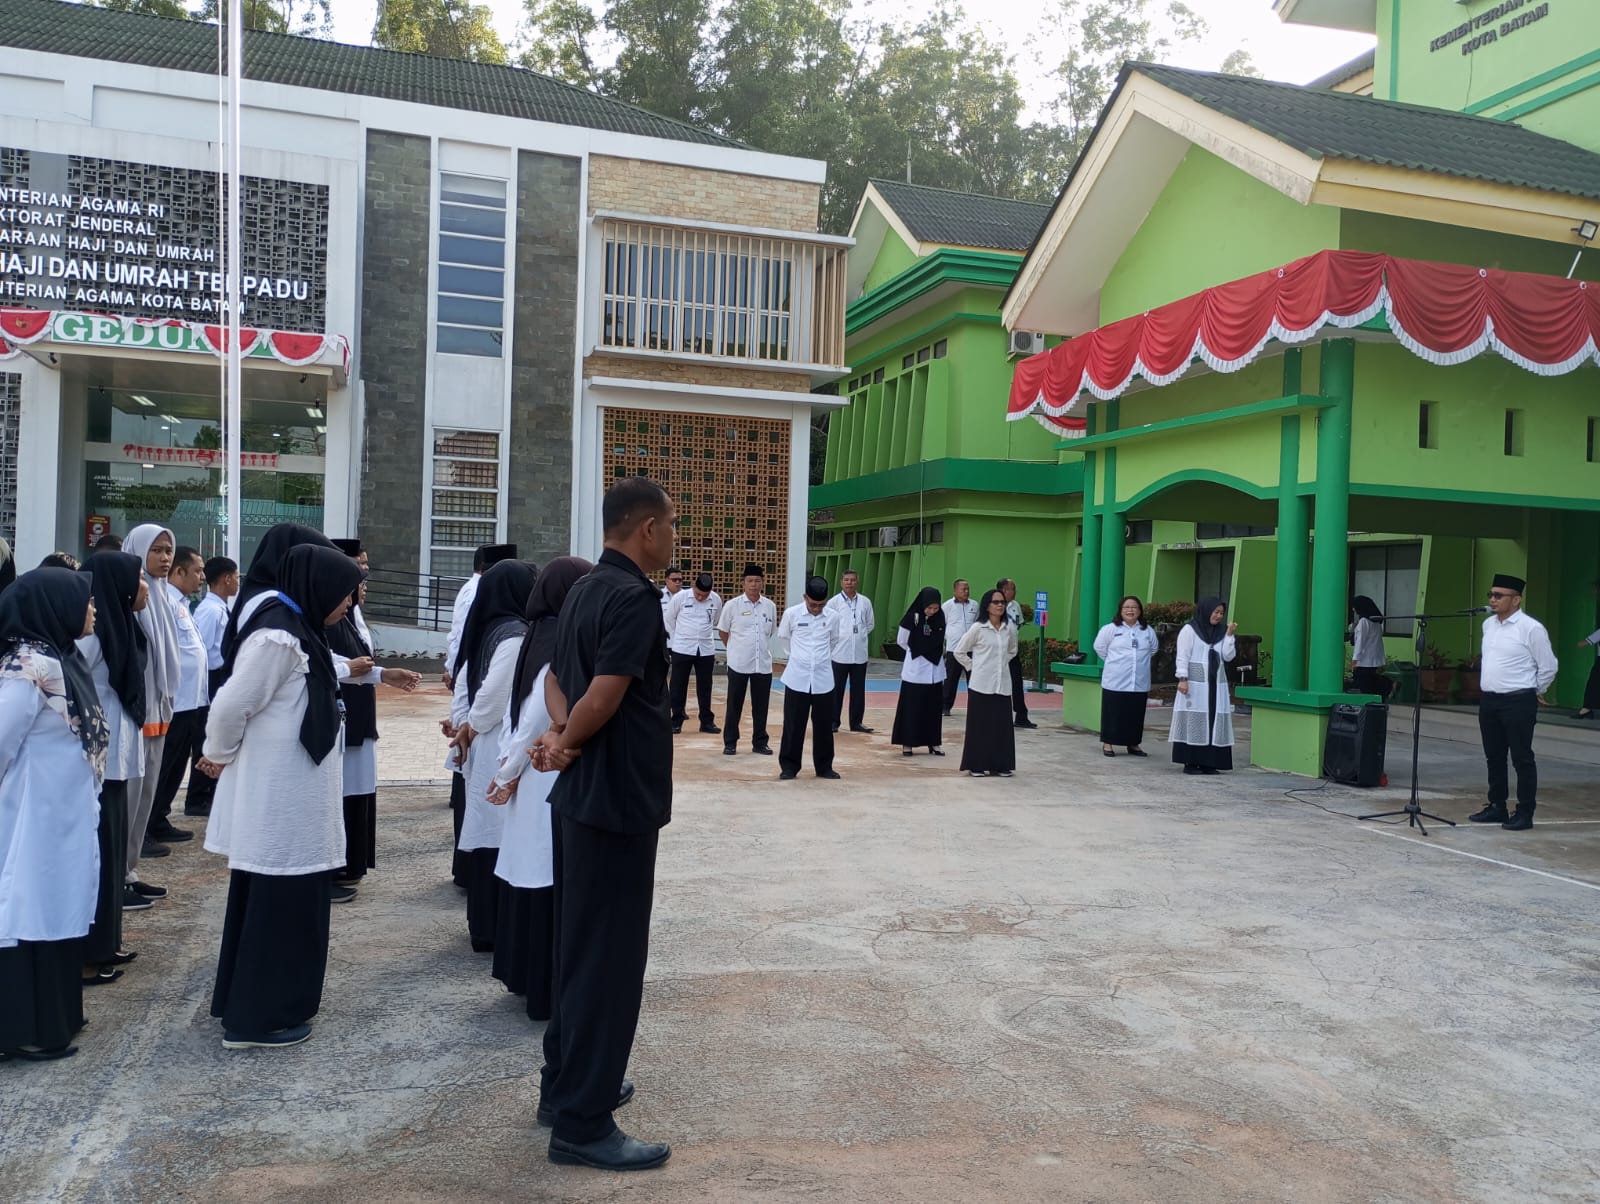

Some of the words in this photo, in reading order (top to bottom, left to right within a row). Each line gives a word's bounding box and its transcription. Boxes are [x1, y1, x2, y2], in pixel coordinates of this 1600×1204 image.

[1430, 0, 1524, 52] KEMENTERIAN
[1462, 29, 1498, 56] KOTA
[1500, 2, 1549, 37] BATAM
[80, 197, 141, 215] AGAMA
[148, 203, 164, 218] RI
[71, 214, 156, 236] JENDERAL
[68, 235, 106, 252] HAJI
[114, 240, 148, 256] DAN
[156, 244, 214, 263] UMRAH
[49, 256, 97, 280] DAN
[105, 262, 188, 289] UMRAH
[75, 287, 135, 305] AGAMA
[142, 293, 183, 310] KOTA
